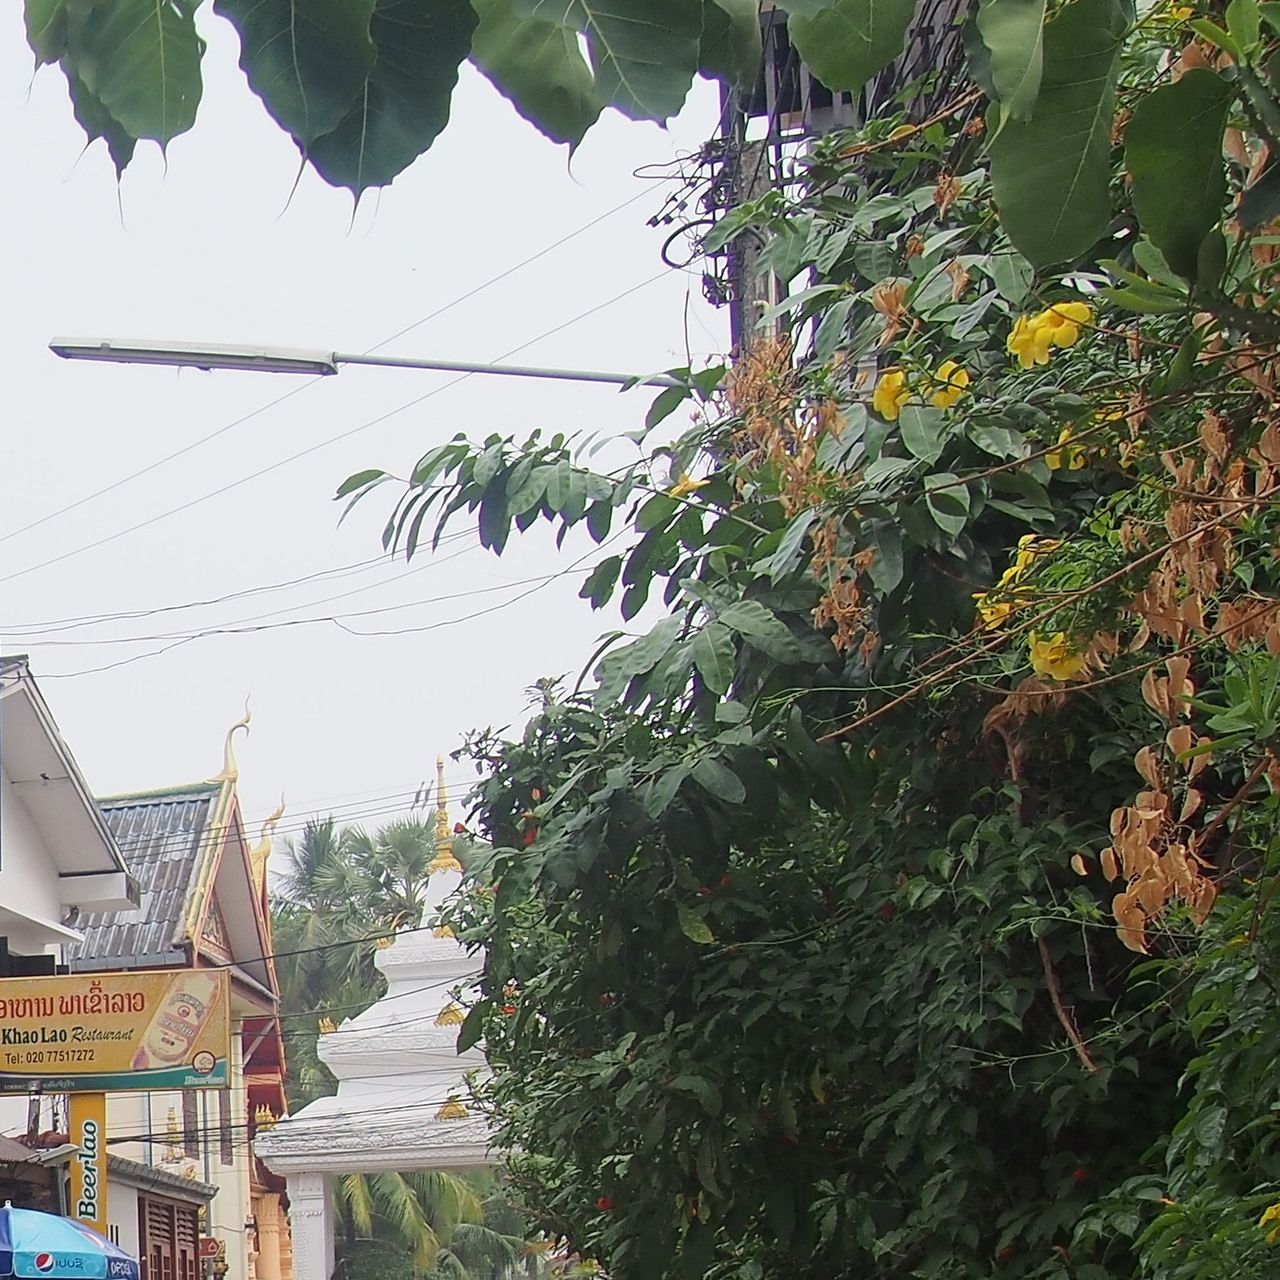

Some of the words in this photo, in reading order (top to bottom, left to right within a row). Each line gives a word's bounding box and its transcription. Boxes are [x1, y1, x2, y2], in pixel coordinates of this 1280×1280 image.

[1, 1027, 39, 1045] Khao
[41, 1027, 68, 1043] Lao
[71, 1026, 135, 1042] Restaurant
[5, 1053, 23, 1065] Tel:
[26, 1052, 43, 1063] 020
[46, 1049, 95, 1062] 77517272
[78, 1121, 97, 1220] Beerlao
